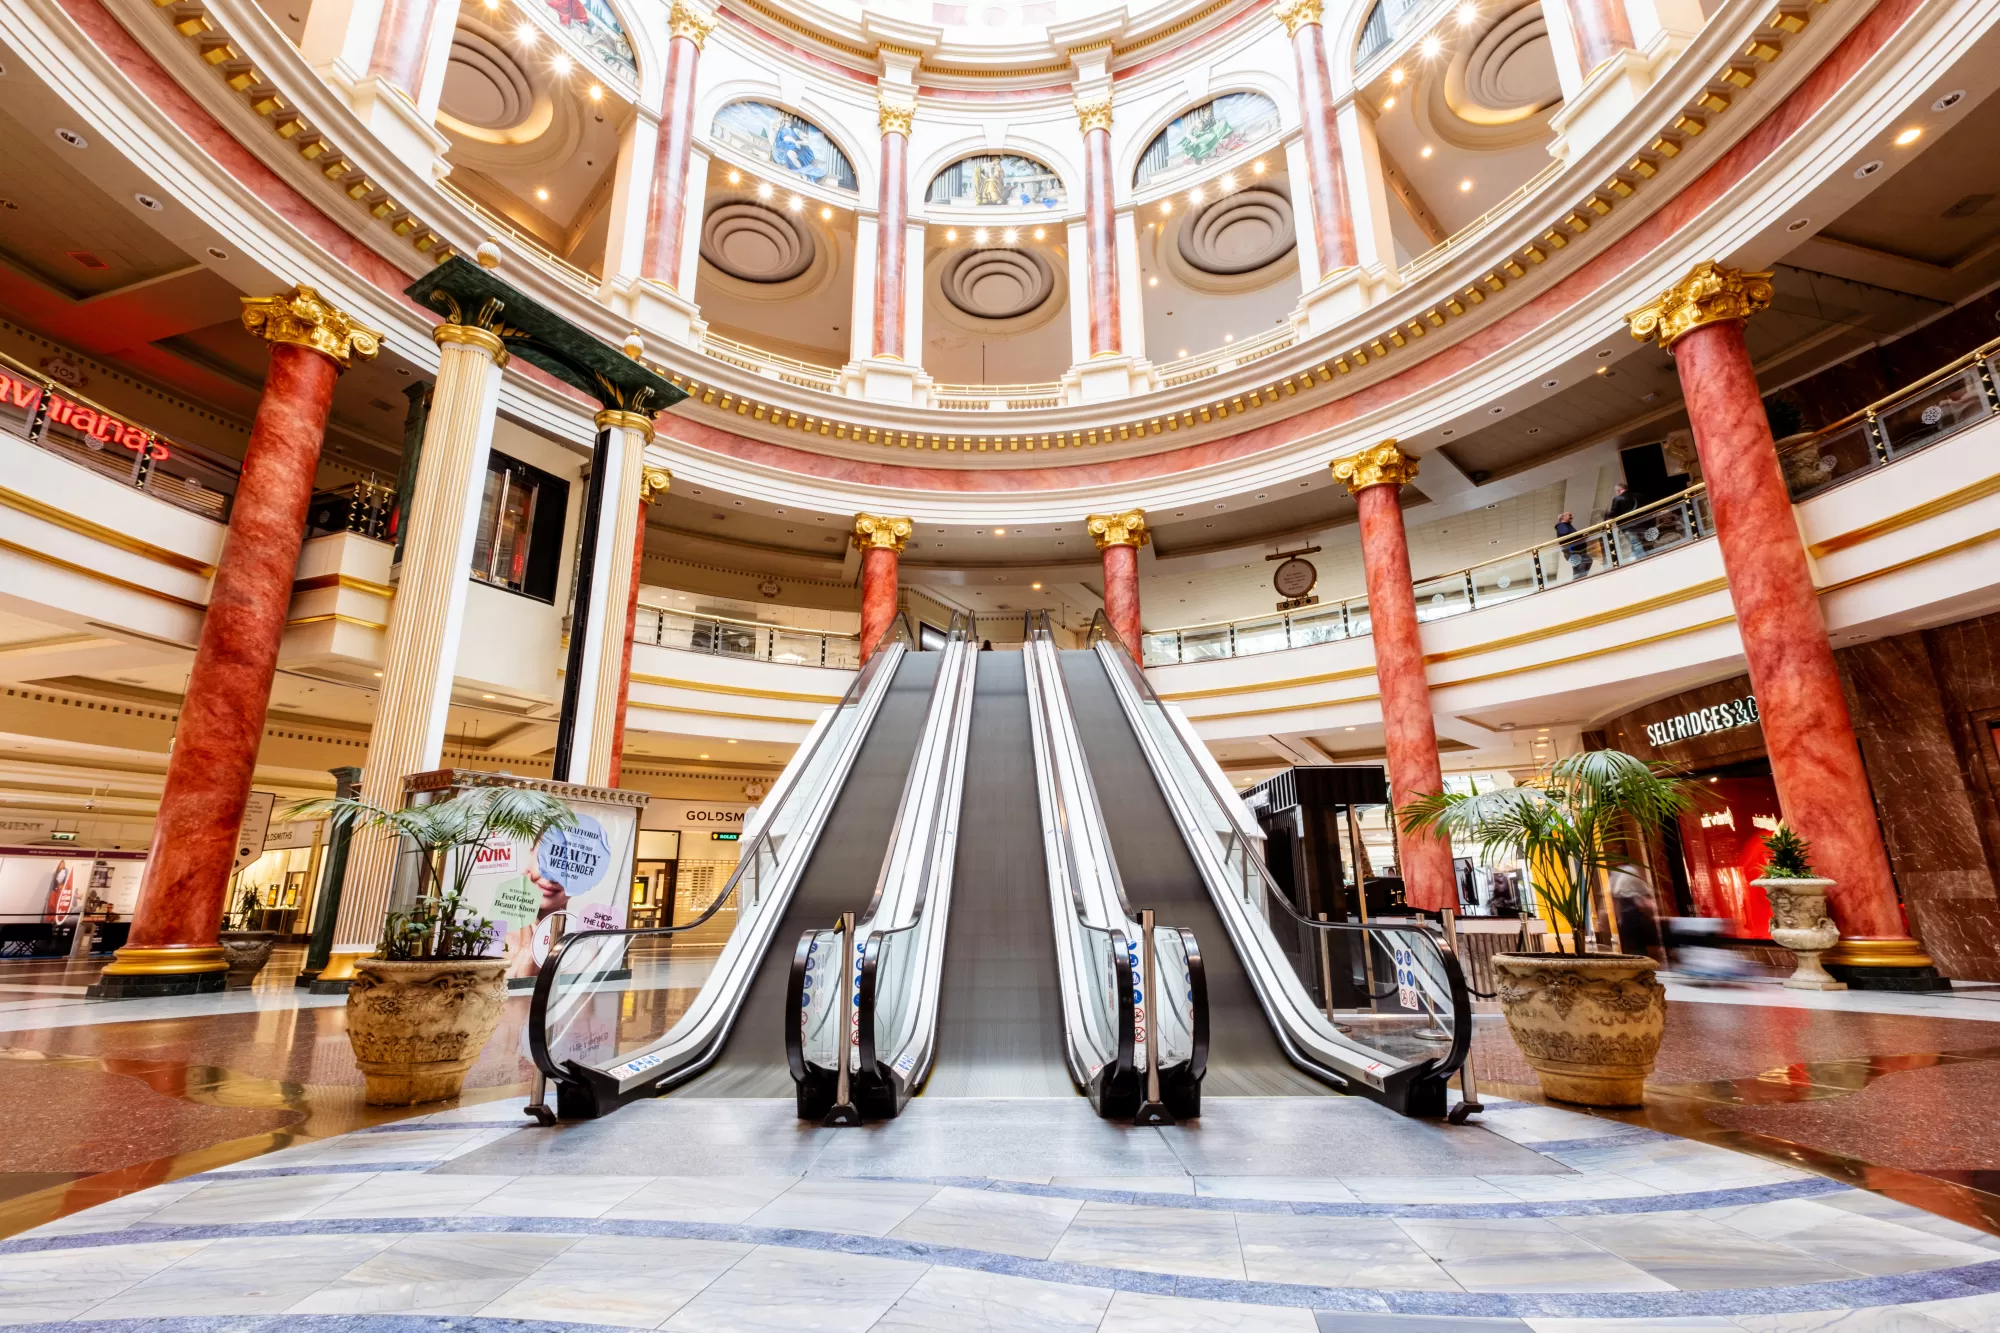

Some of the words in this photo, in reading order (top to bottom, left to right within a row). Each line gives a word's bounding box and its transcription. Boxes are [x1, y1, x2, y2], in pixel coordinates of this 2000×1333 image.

[53, 364, 76, 380] 105
[476, 848, 511, 863] WIN
[550, 844, 601, 866] BEAUTY
[550, 857, 595, 876] WEEKENDER
[501, 892, 516, 901] Feel
[516, 895, 535, 905] Good
[494, 899, 518, 912] Beauty
[518, 903, 537, 914] Show
[583, 916, 596, 926] THE
[596, 920, 619, 931] LOOKS
[594, 911, 613, 922] SHOP
